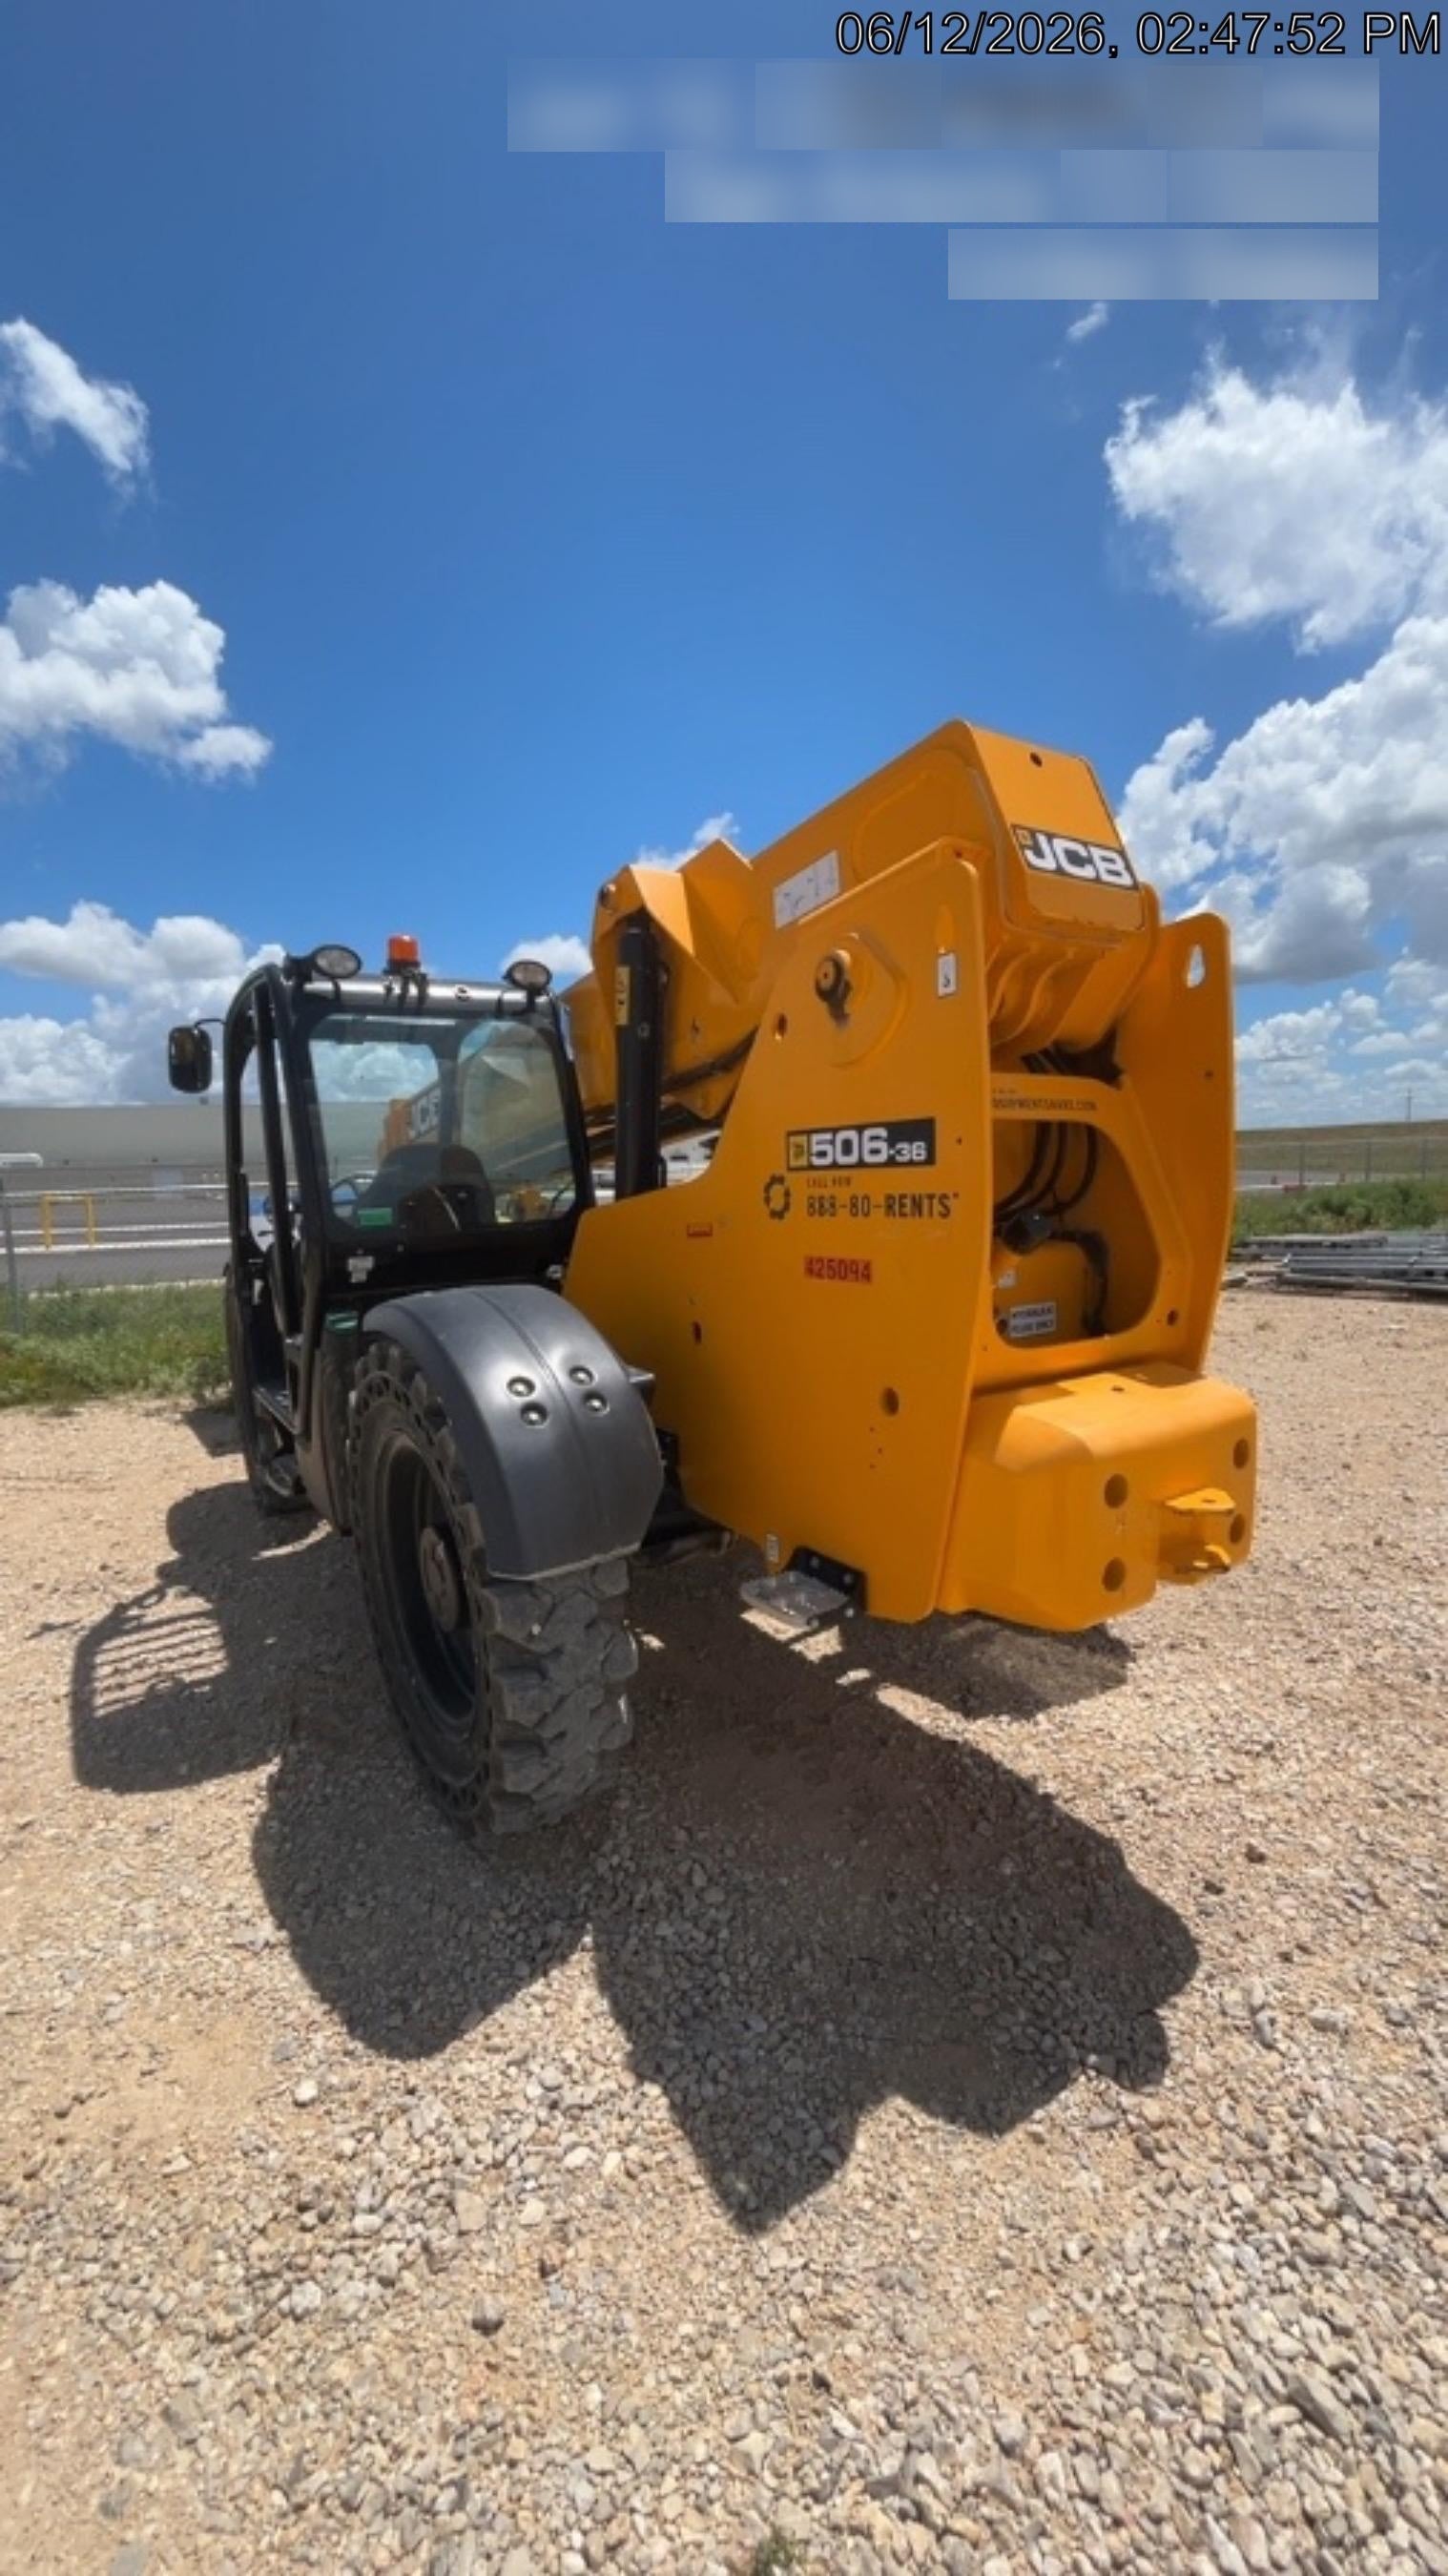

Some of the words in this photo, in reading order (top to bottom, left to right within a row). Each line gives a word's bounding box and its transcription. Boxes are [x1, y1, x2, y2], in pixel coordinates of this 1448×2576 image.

[1024, 831, 1134, 886] JCB
[810, 1127, 927, 1167] 506-36
[804, 1256, 873, 1283] 425094
